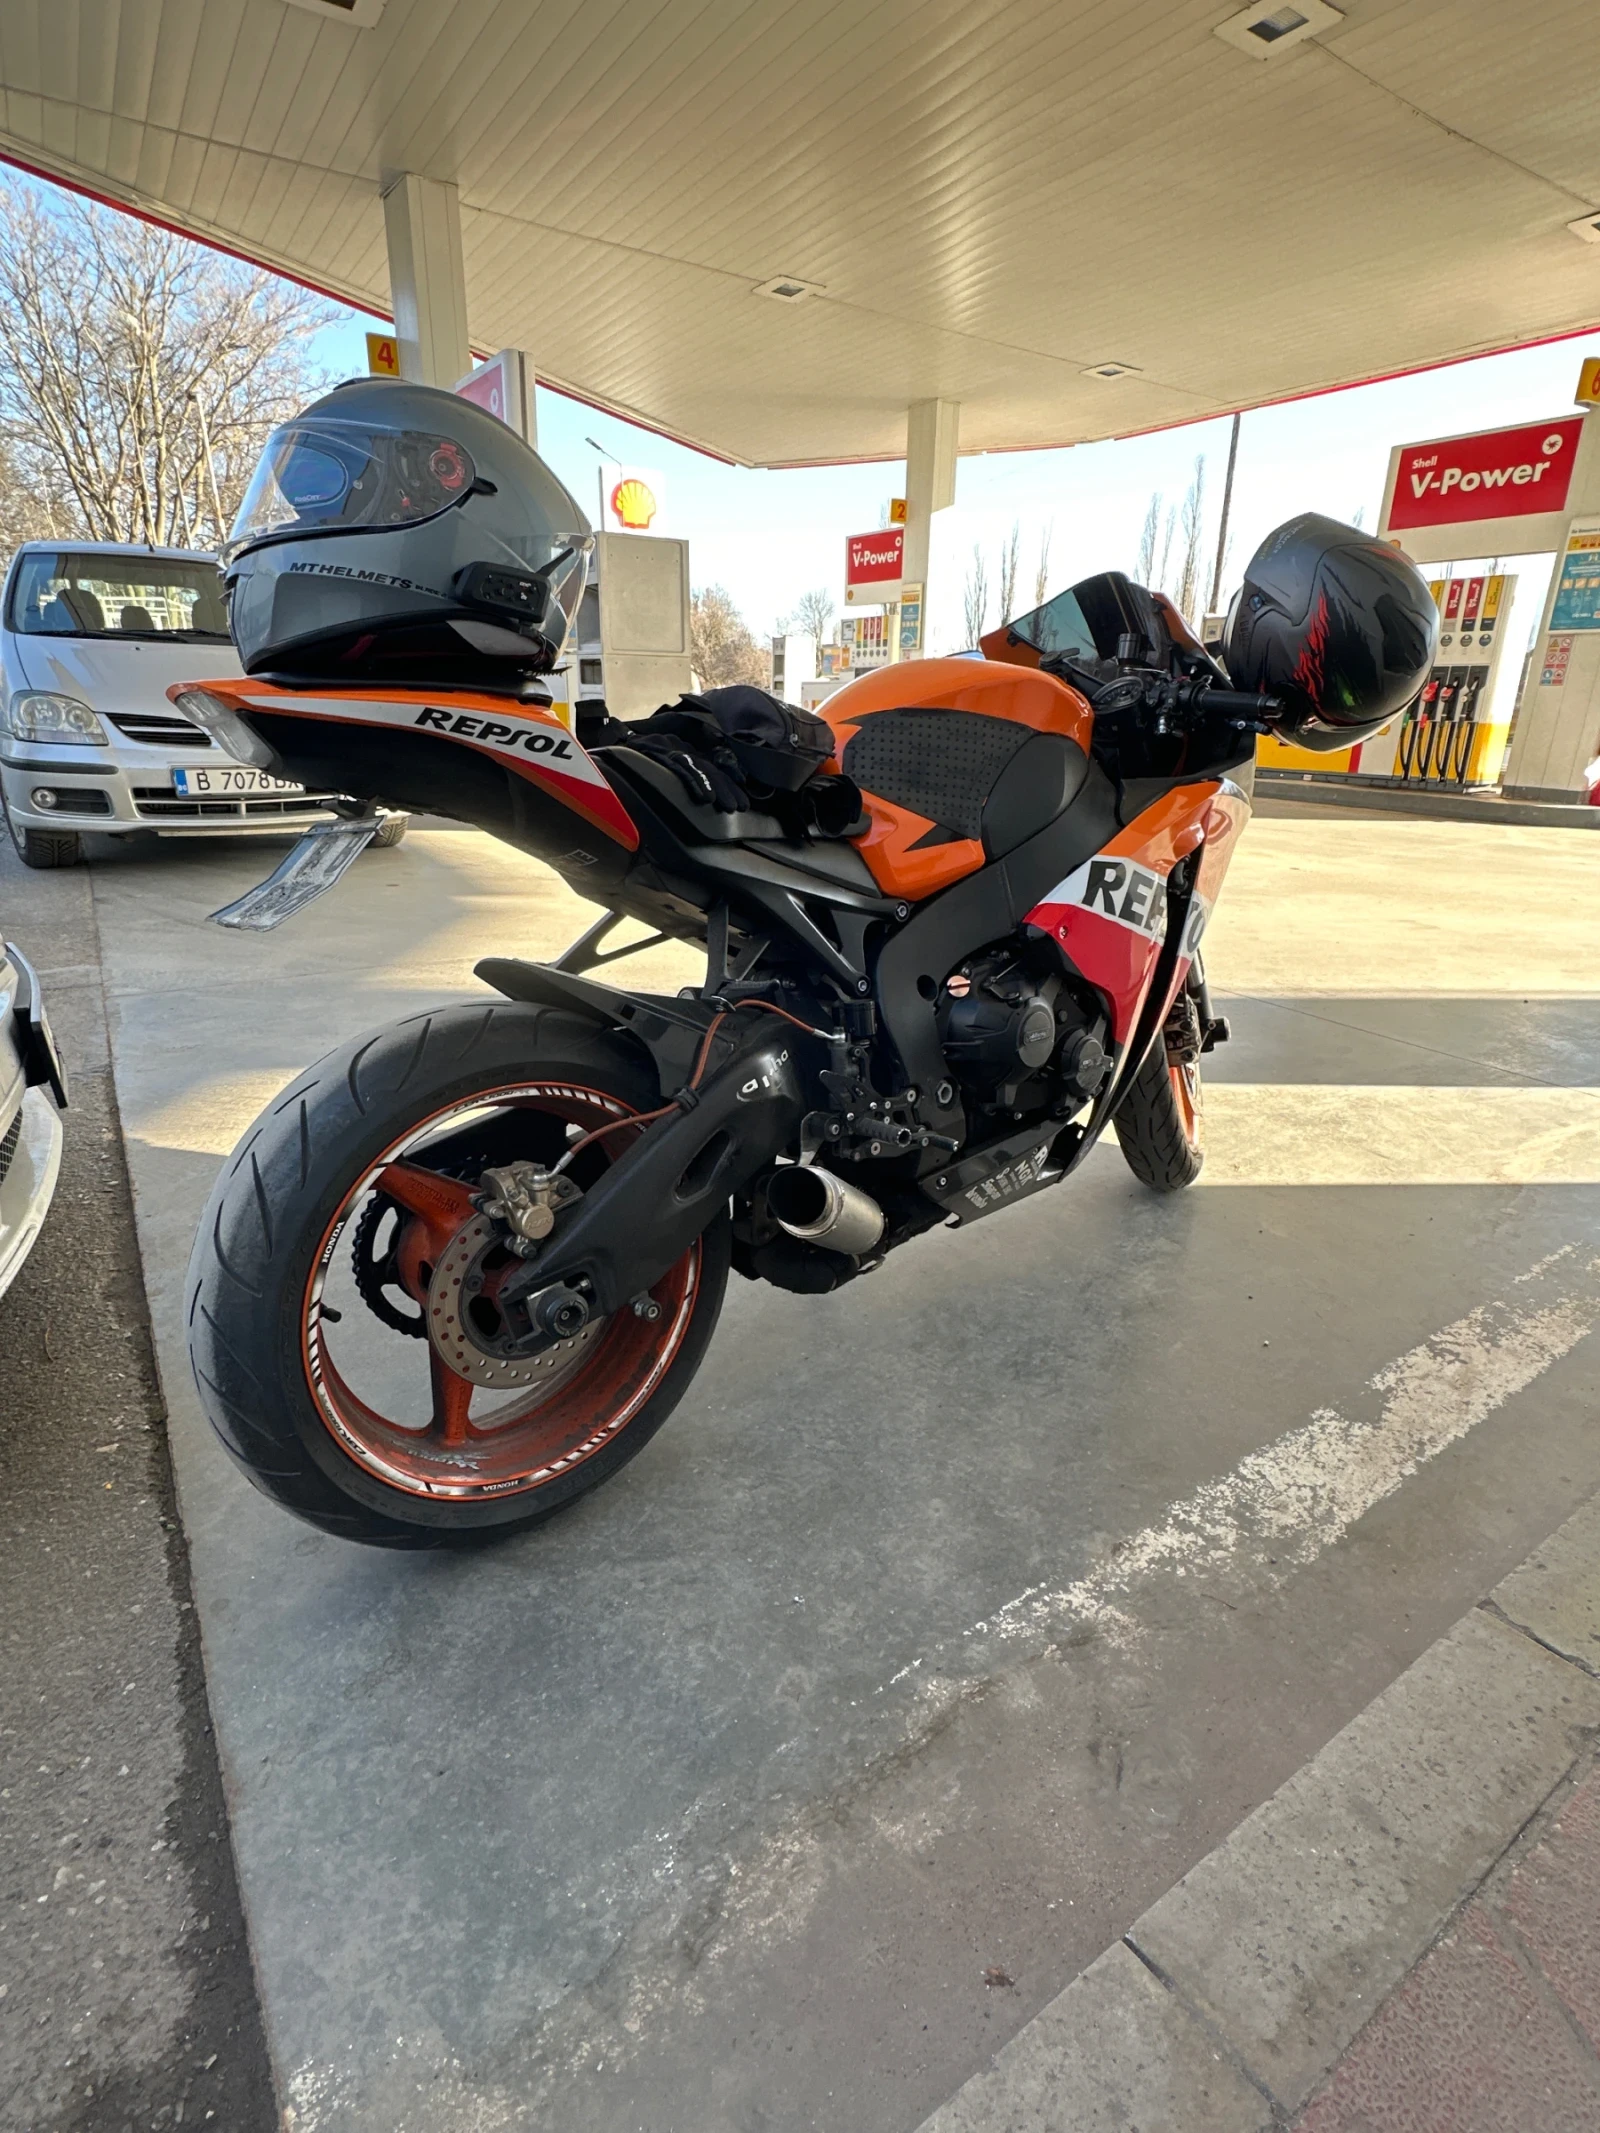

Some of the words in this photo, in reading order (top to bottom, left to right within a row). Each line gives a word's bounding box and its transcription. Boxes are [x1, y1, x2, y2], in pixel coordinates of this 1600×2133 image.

[378, 342, 394, 369] 4
[1411, 455, 1438, 469] Shell
[1410, 461, 1551, 499] V-Power
[897, 503, 906, 519] 2
[852, 550, 899, 567] V-Power
[414, 707, 573, 760] REPSOL
[196, 772, 211, 790] B
[220, 771, 270, 790] 7078
[1014, 1160, 1033, 1186] NGK
[321, 1221, 345, 1264] HONDA
[482, 1479, 519, 1492] HONDA
